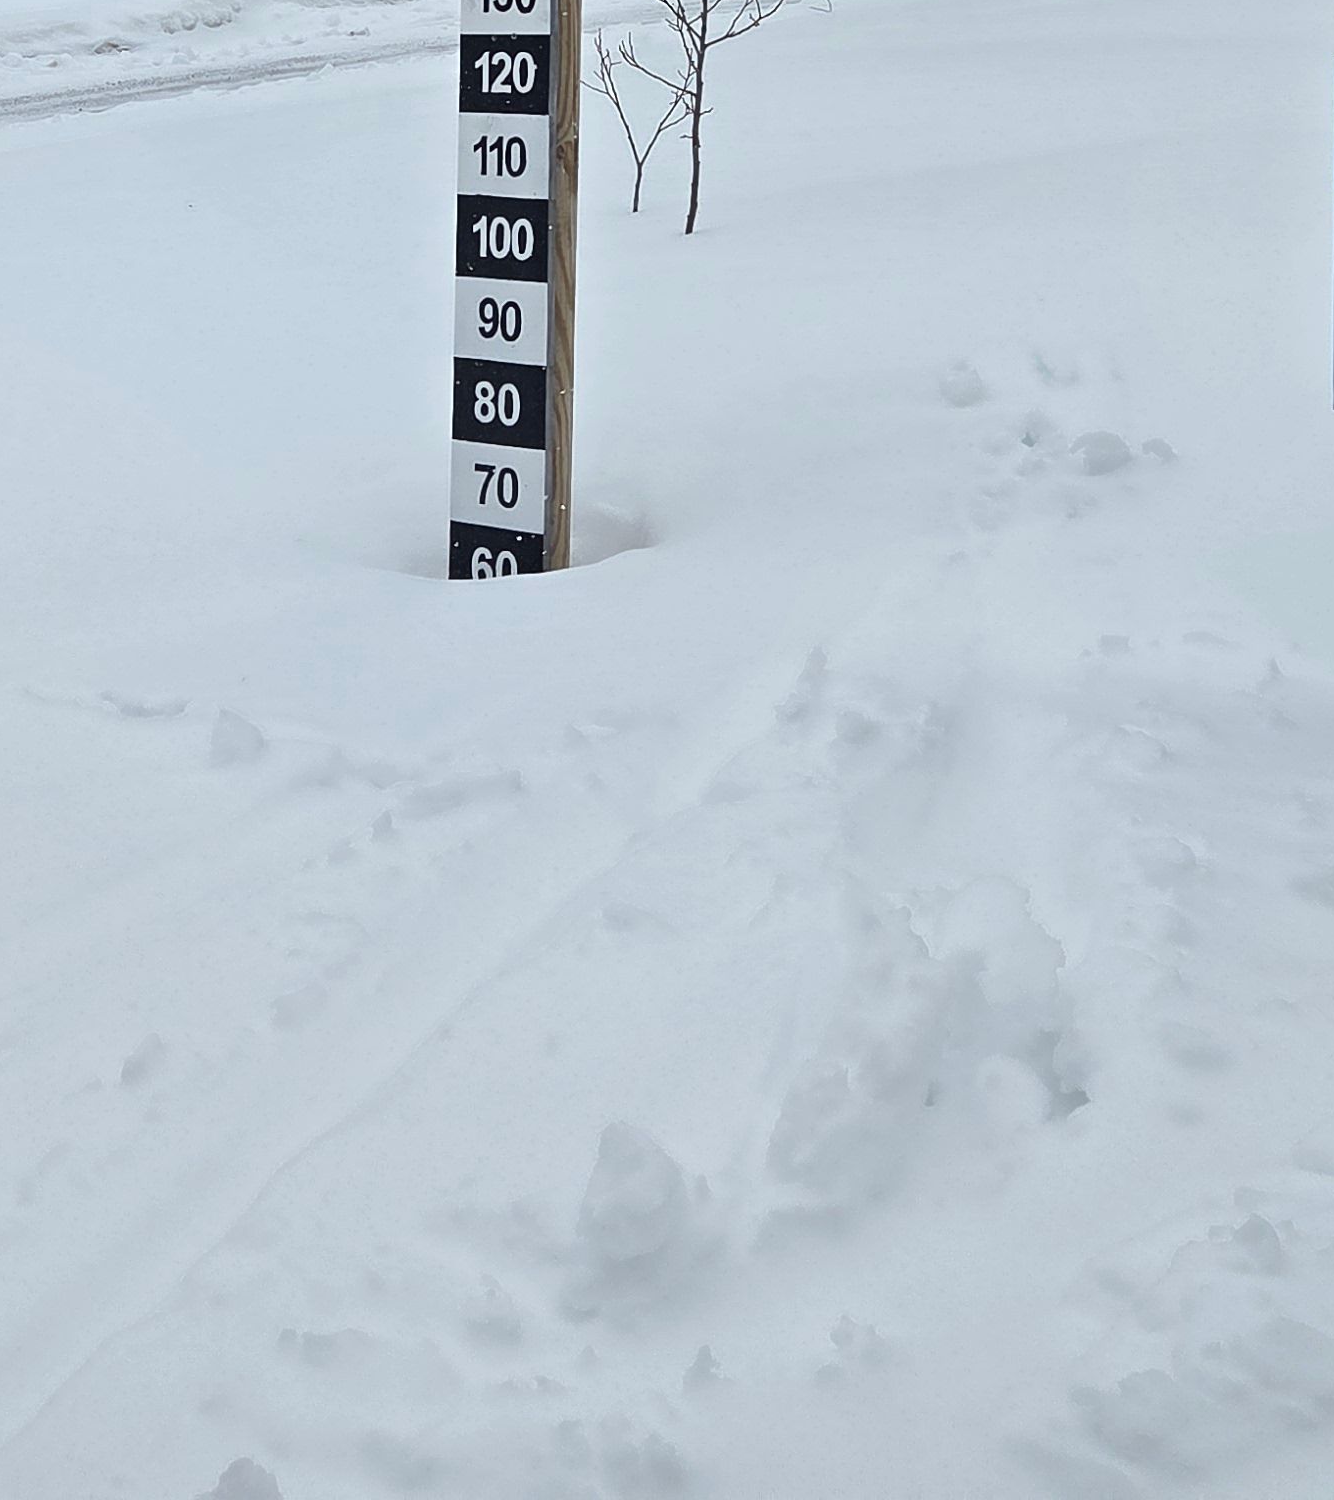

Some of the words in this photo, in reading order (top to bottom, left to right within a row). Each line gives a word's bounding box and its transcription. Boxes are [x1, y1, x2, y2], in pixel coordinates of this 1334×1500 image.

[474, 51, 537, 95] 120
[472, 136, 527, 179] 110
[472, 217, 534, 262] 100
[478, 298, 522, 342] 90
[474, 381, 521, 427] 80
[473, 464, 519, 509] 70
[471, 546, 518, 580] 60
